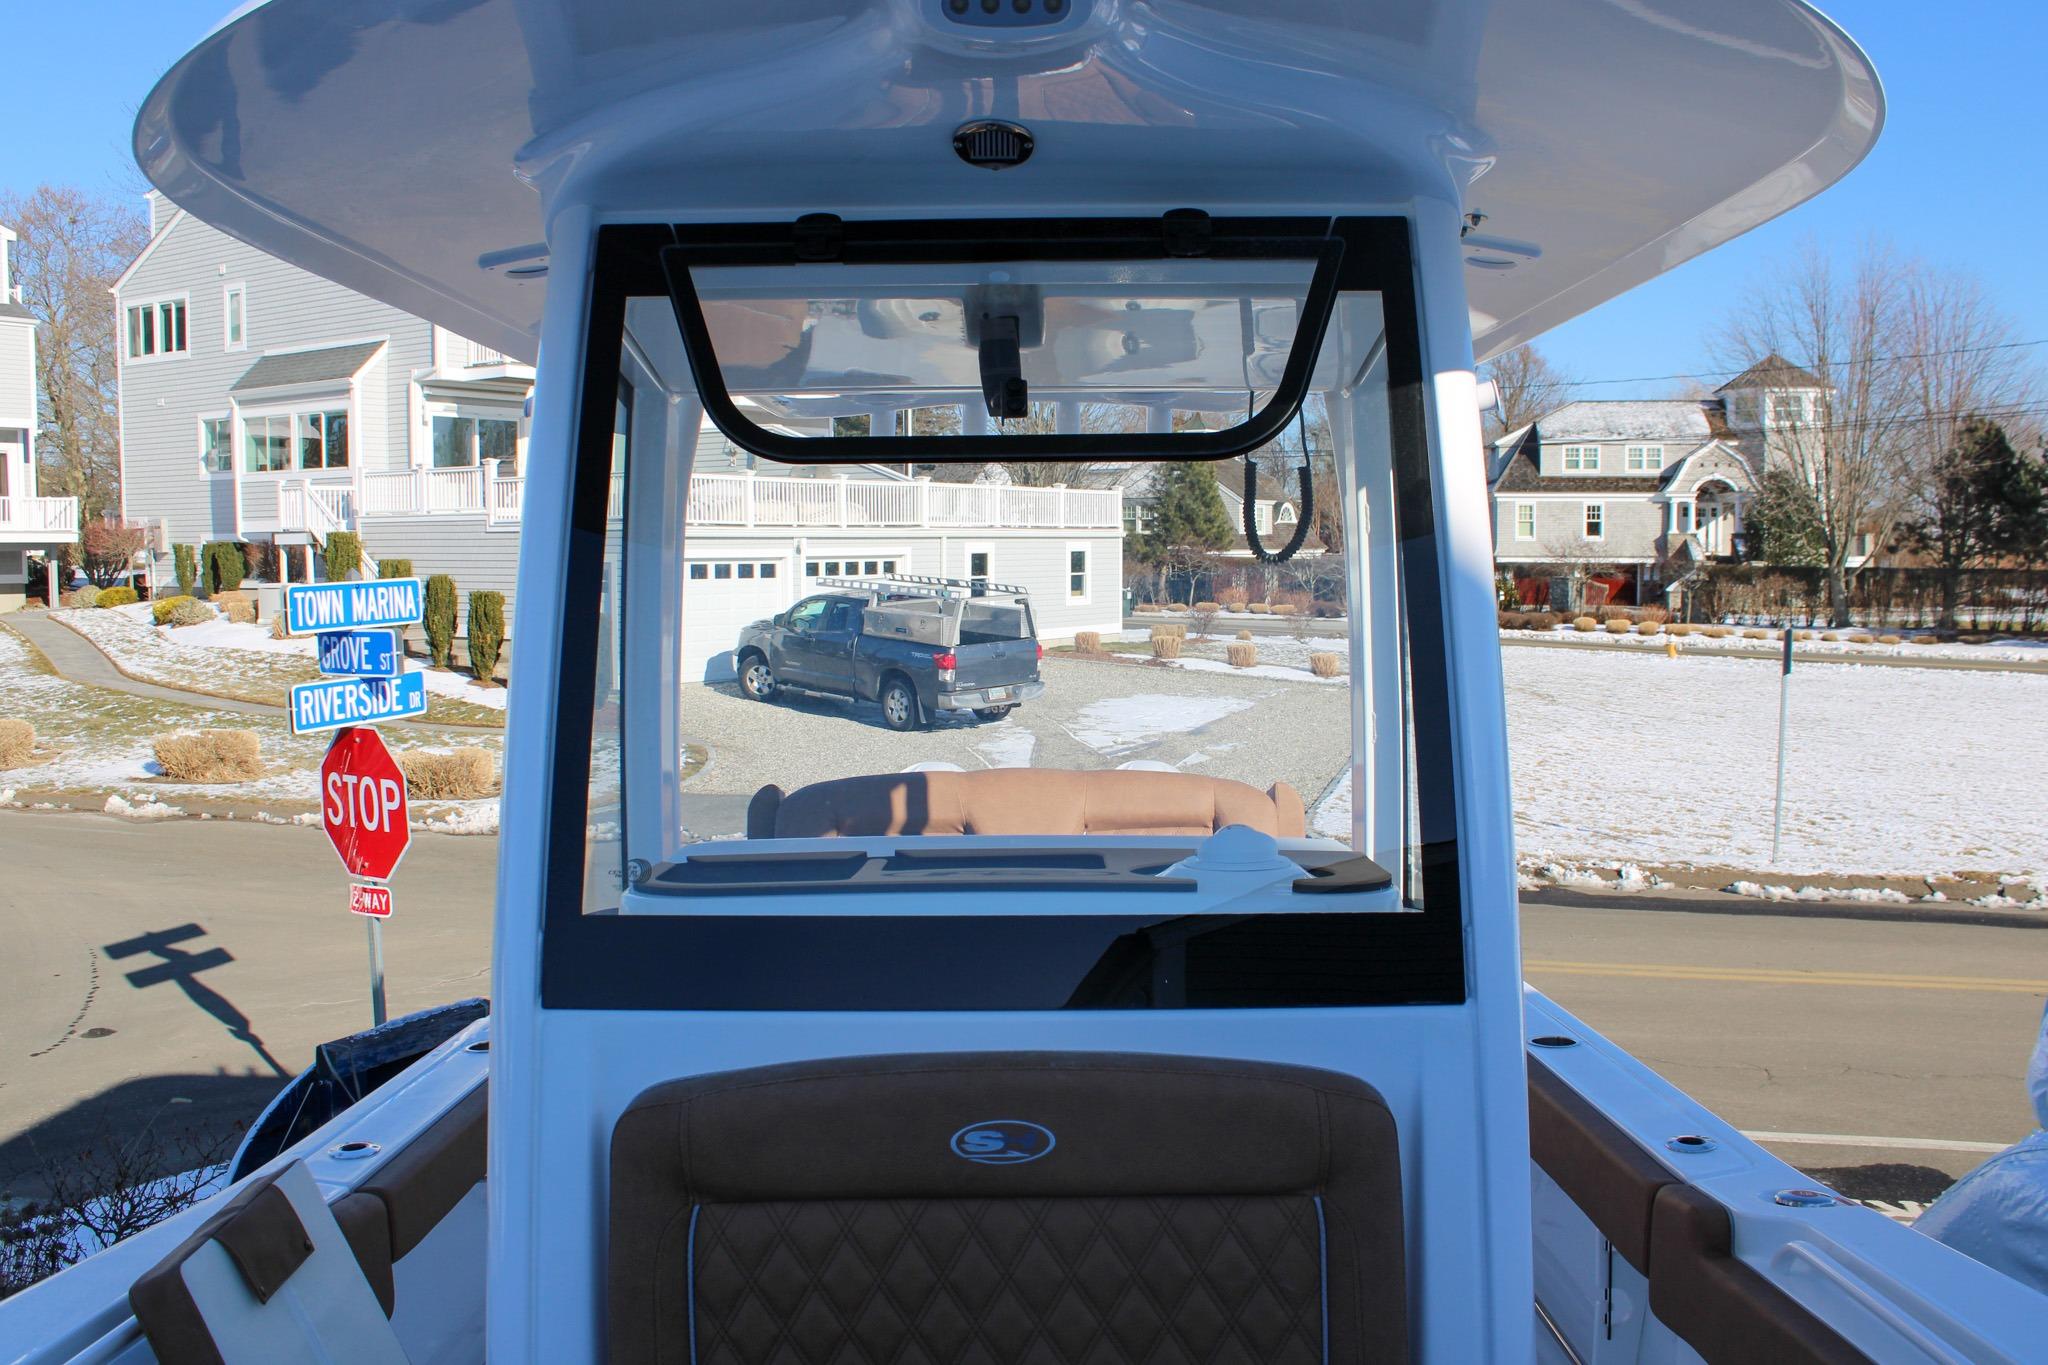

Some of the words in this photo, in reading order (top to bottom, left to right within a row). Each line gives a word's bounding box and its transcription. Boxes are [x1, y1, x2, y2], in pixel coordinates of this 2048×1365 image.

[293, 589, 345, 627] TOWN
[352, 585, 417, 622] MARINA
[321, 635, 373, 670] GROVE
[380, 653, 391, 670] ST
[300, 679, 404, 725] RIVERSIDE
[409, 691, 421, 709] DR
[327, 771, 400, 832] STOP
